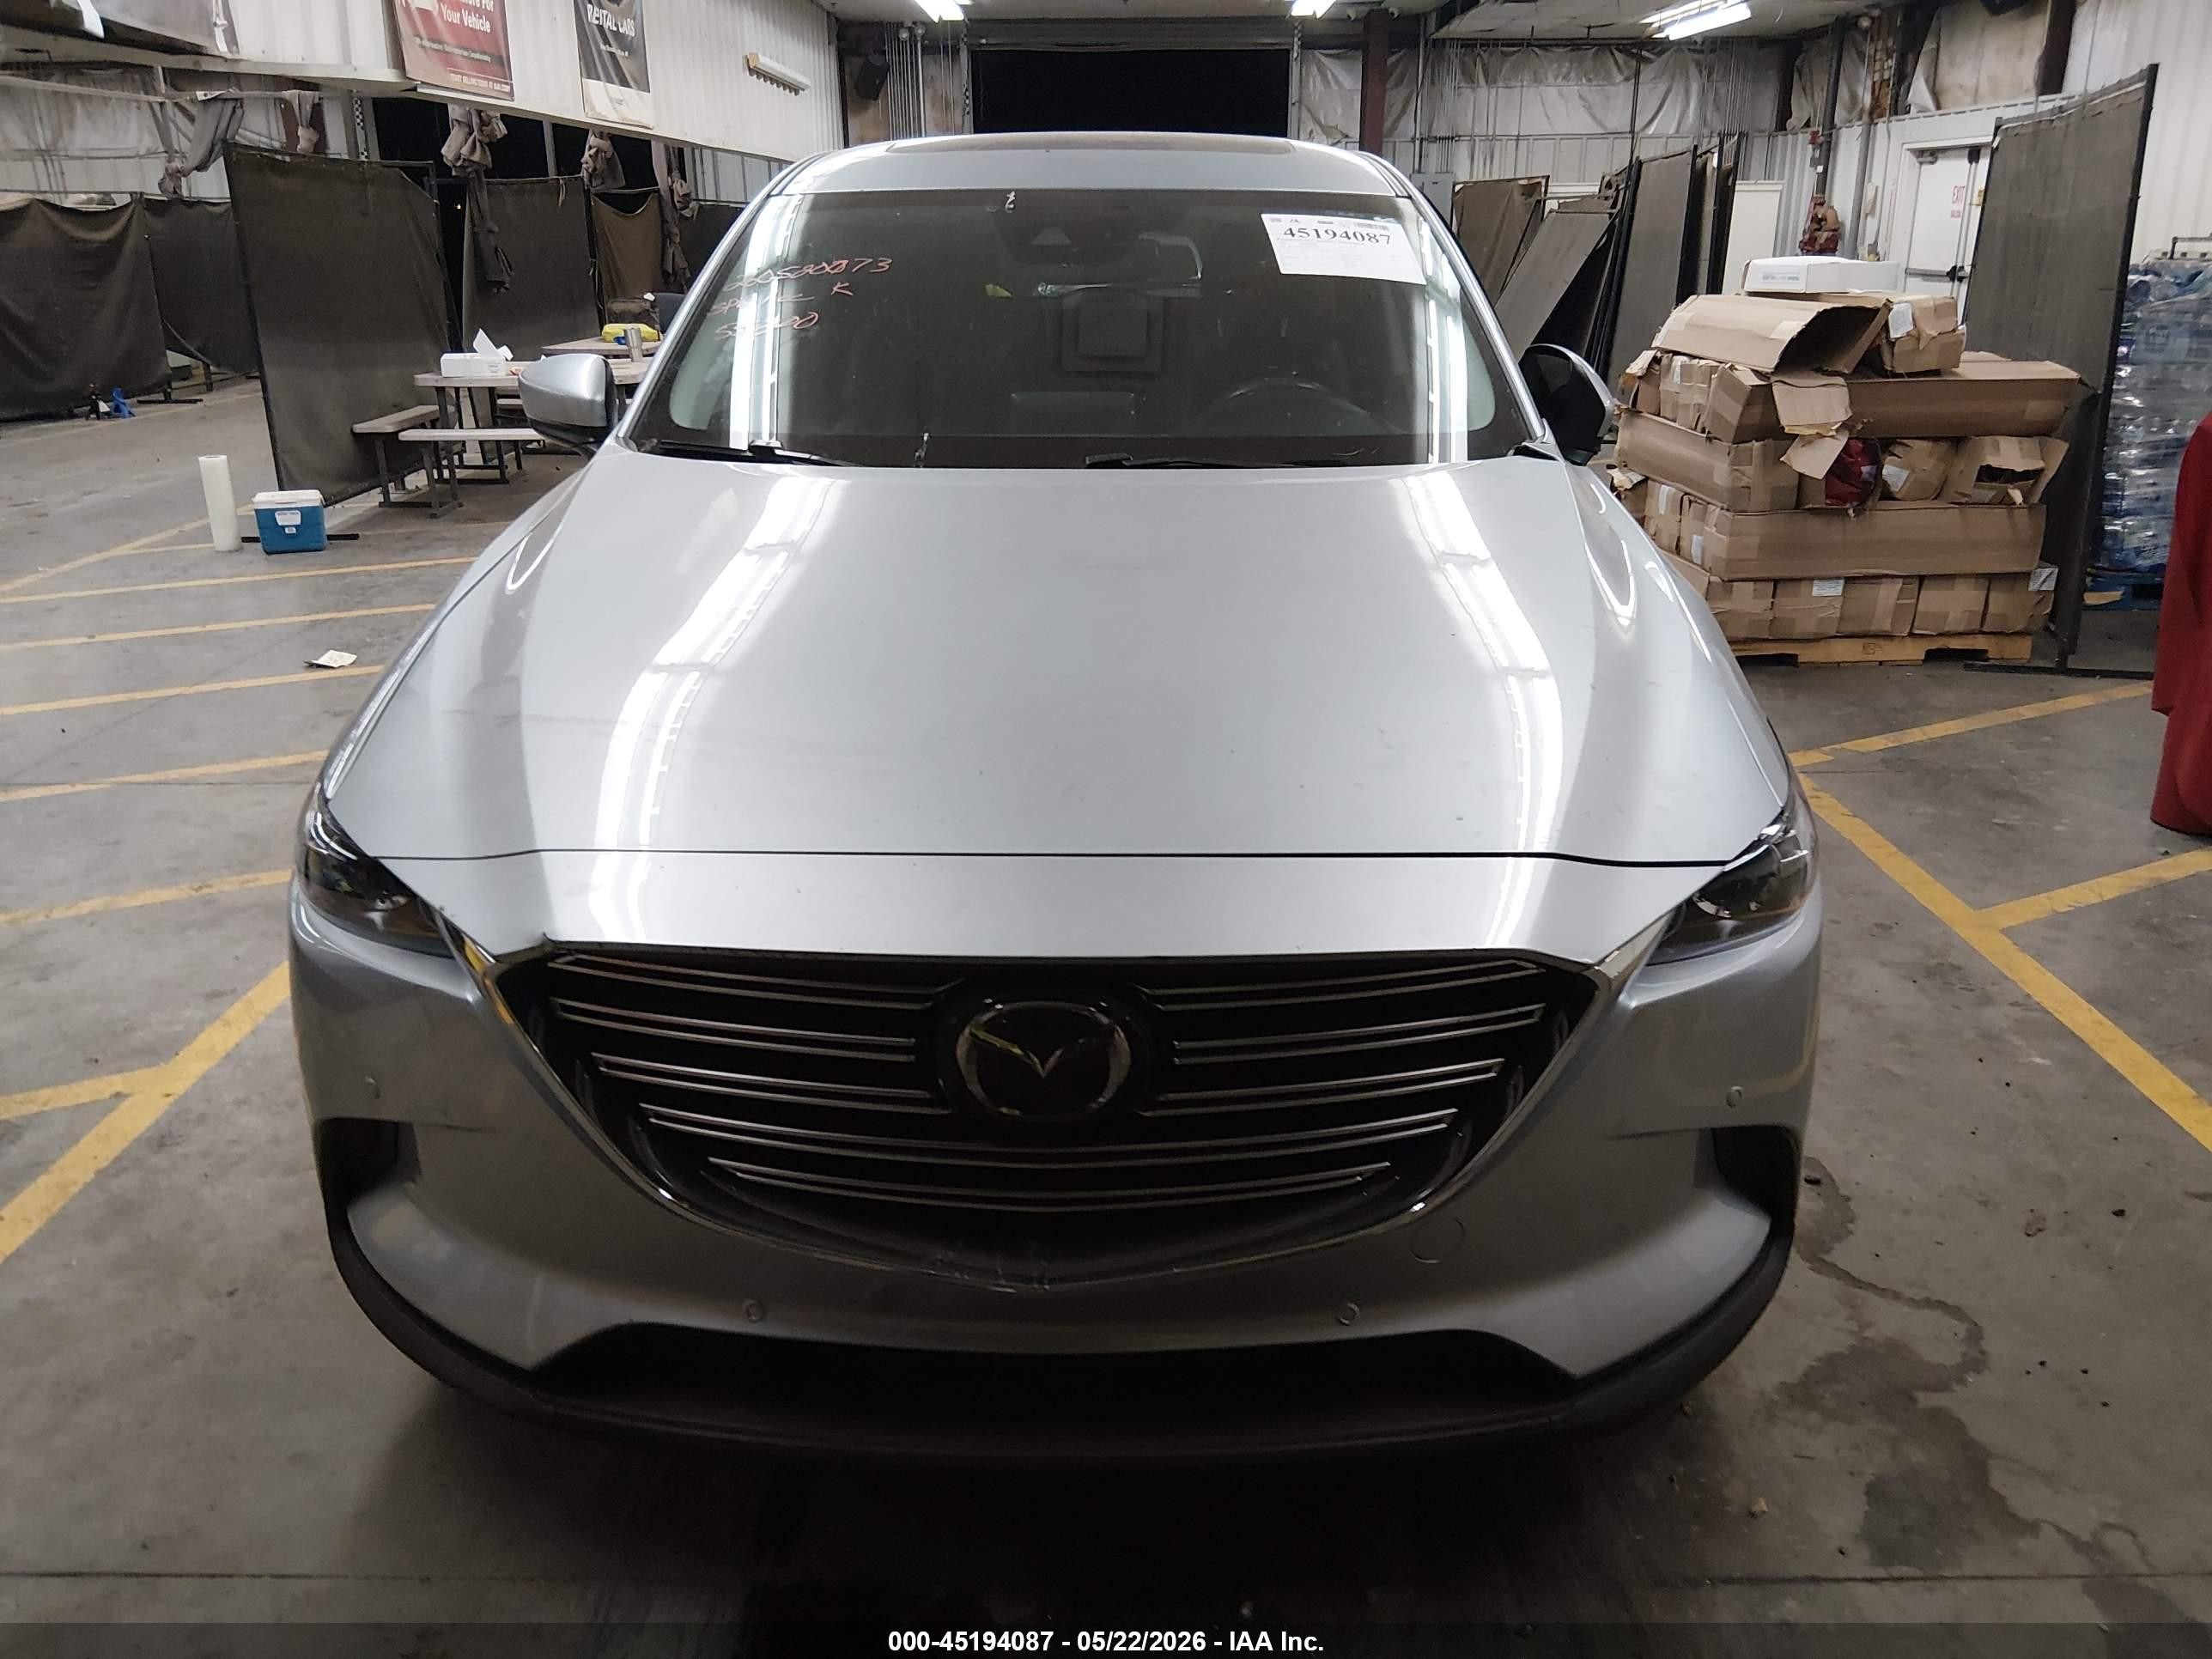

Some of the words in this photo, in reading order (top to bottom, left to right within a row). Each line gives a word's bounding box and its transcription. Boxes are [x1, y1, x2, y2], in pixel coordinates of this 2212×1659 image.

[440, 3, 461, 25] Your
[462, 8, 491, 33] Vehicle
[617, 15, 635, 37] CARS
[1283, 226, 1391, 246] 45194087
